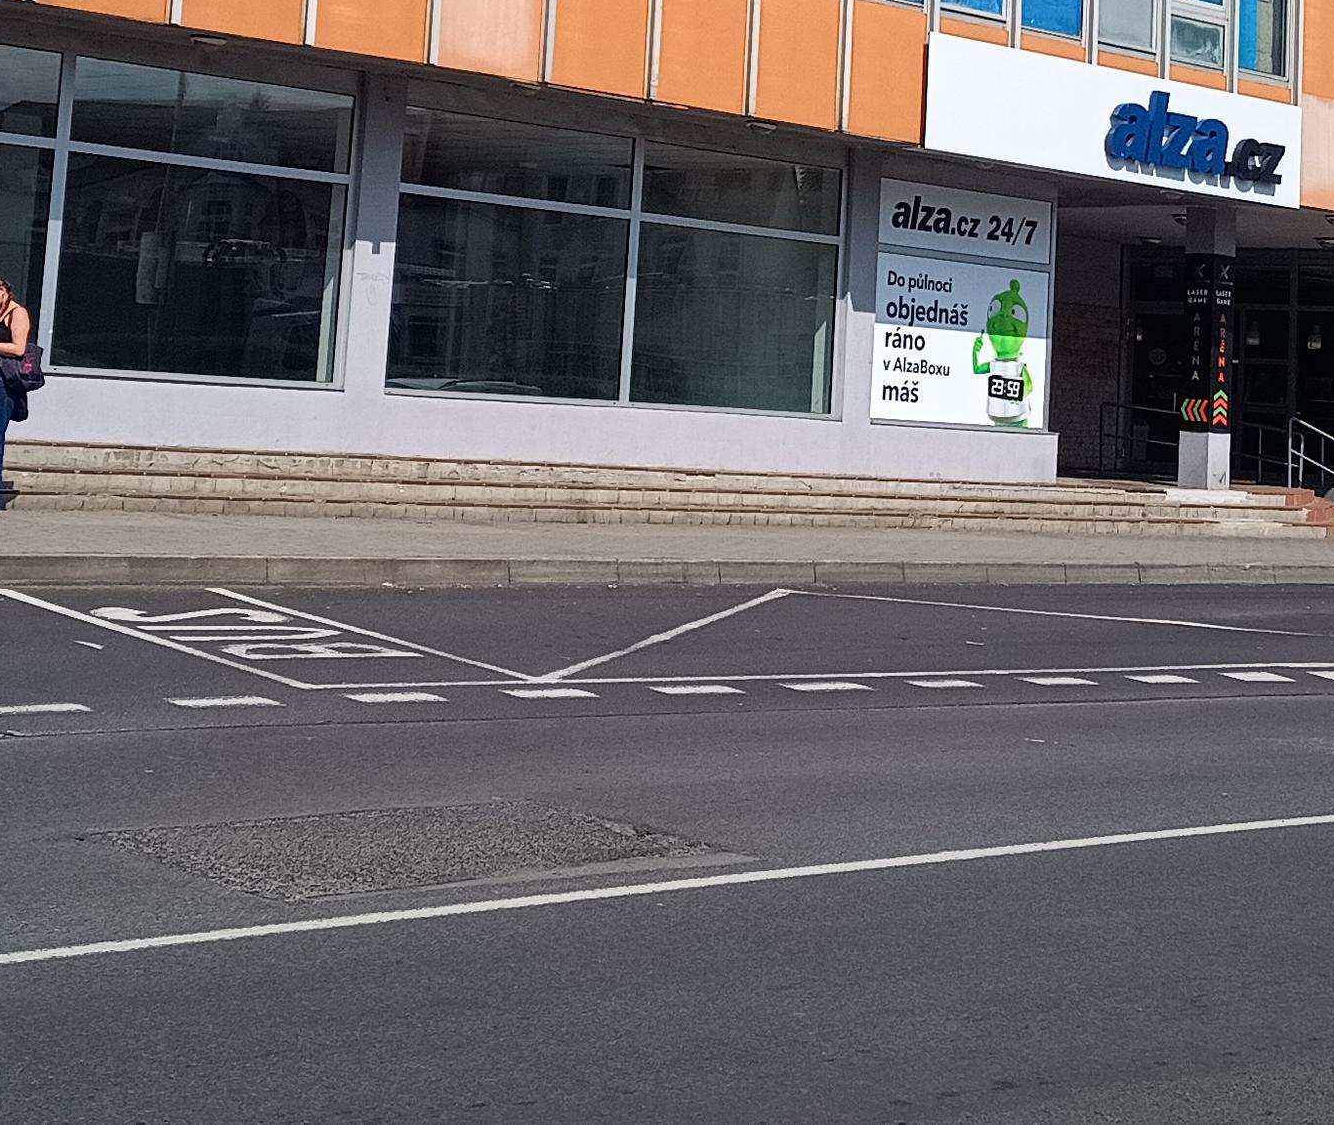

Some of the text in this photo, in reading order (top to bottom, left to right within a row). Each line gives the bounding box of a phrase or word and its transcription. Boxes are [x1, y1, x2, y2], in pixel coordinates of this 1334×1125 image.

[1104, 90, 1286, 185] alza.cz
[891, 195, 1038, 246] alza.cz 24/7
[887, 270, 953, 293] Do půlnoci
[1215, 289, 1232, 298] LASER
[886, 295, 969, 327] objednáš
[885, 327, 925, 351] ráno
[883, 356, 950, 376] v AlzaBoxu
[882, 380, 919, 403] máš
[990, 378, 1021, 398] 23:59
[90, 606, 425, 660] BUS
